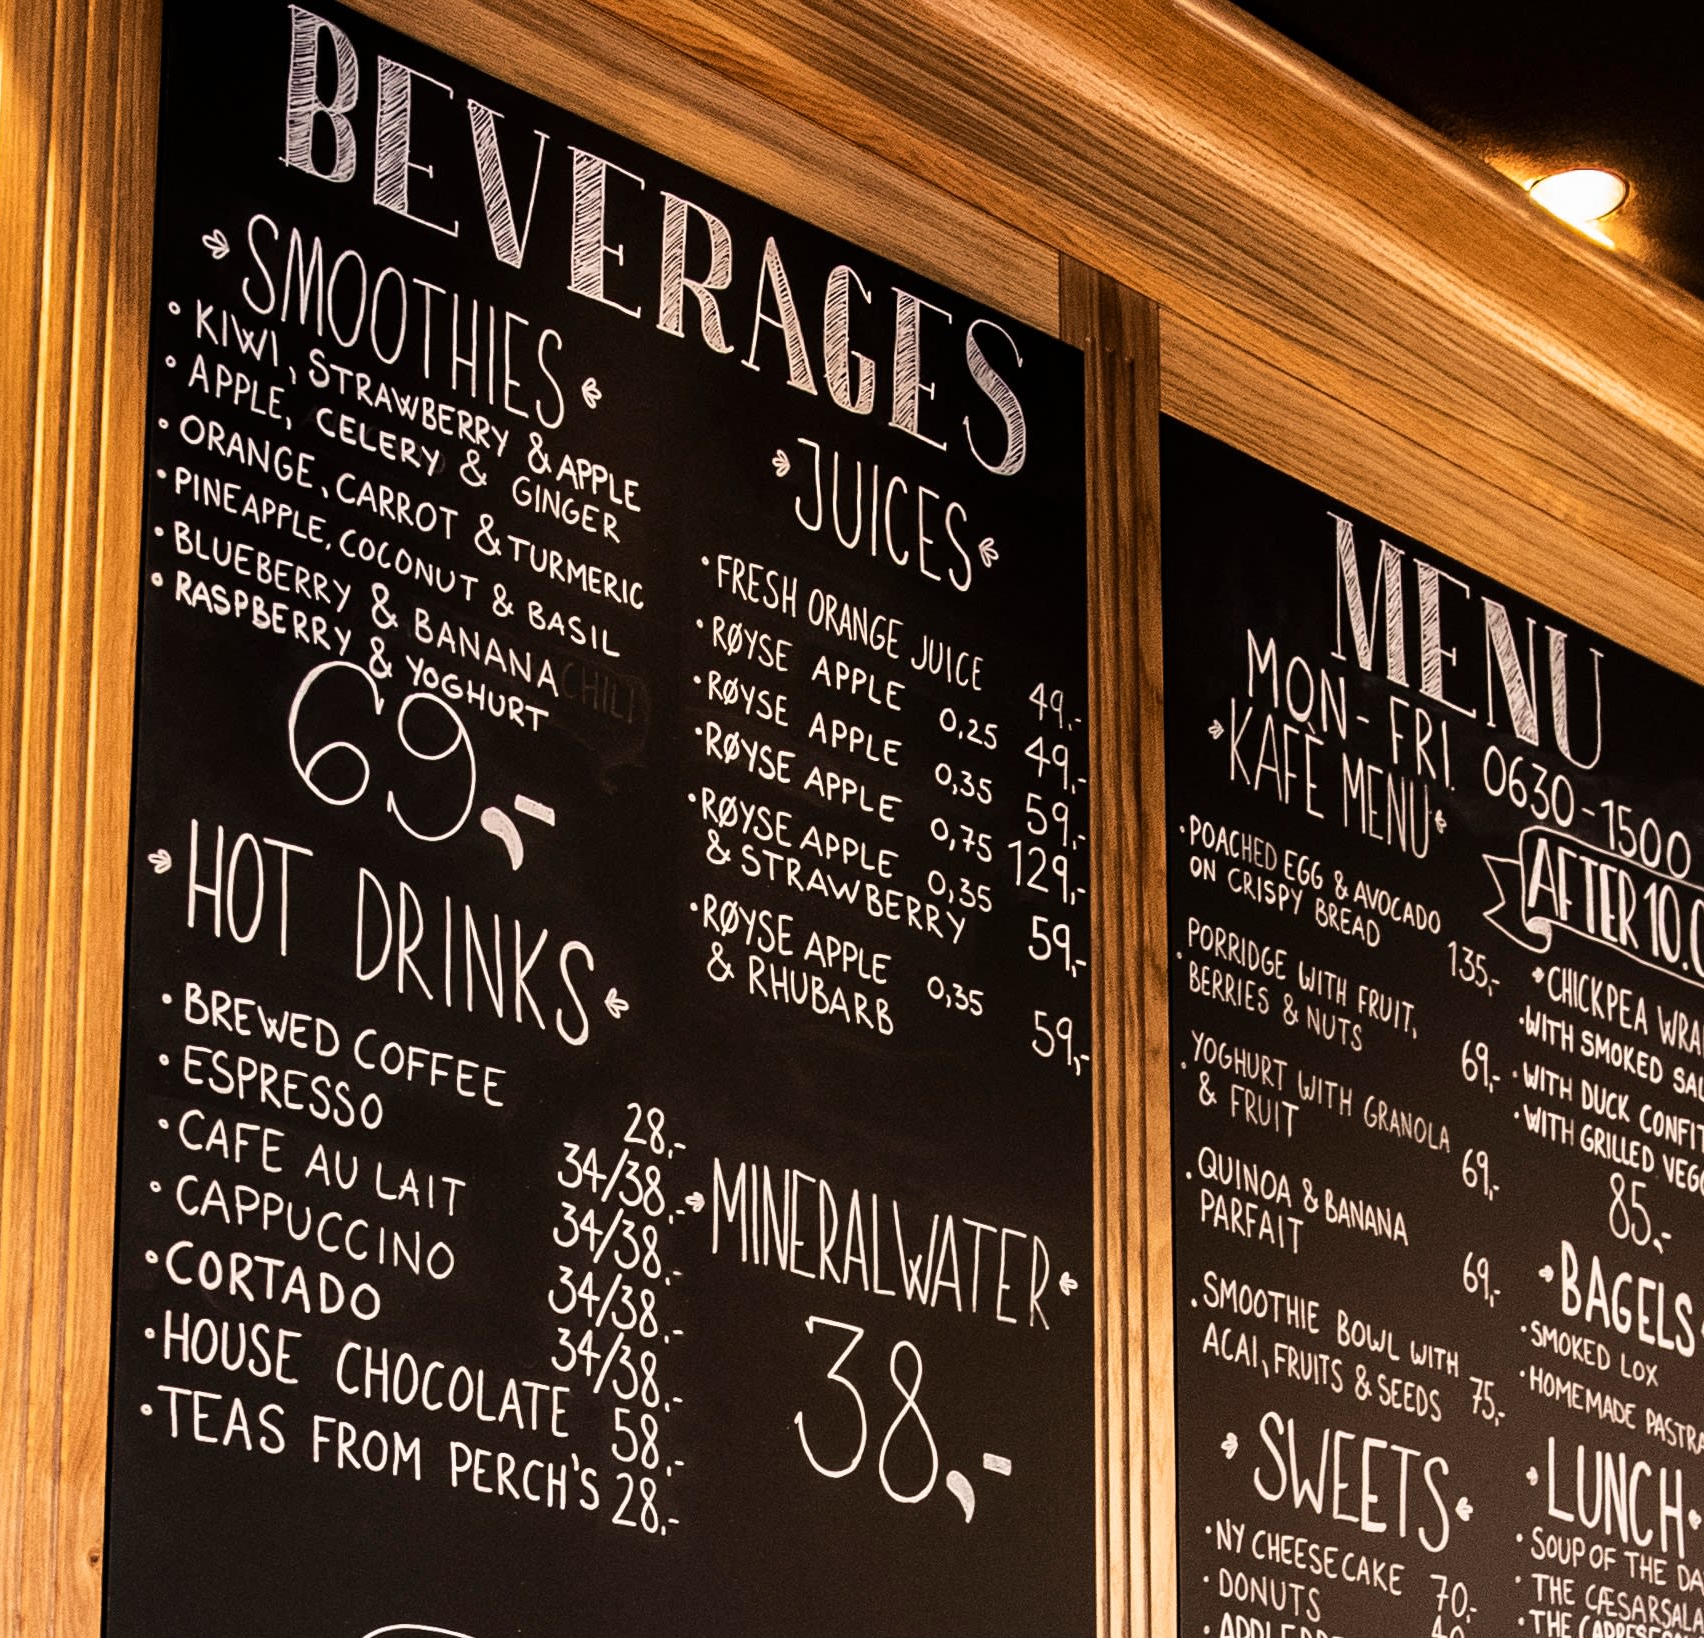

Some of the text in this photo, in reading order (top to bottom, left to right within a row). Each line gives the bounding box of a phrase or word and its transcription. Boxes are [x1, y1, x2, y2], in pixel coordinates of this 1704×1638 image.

[280, 4, 1028, 477] BEVERAGES
[242, 214, 564, 429] SMOOTHIES
[188, 354, 620, 543] APPLE, CELERY GINGER
[197, 299, 641, 512] KIWI, STRAWBERRY APPLE
[175, 467, 620, 657] PINEAPPLE, COCONUT BASIL
[180, 415, 644, 609] ORANGE, CARROT TURMERIC
[795, 437, 972, 592] JUICES
[174, 521, 351, 612] BLUEBERRY
[415, 608, 558, 697] BANANA
[176, 570, 351, 656] RASPBERRY
[406, 655, 549, 731] YOGHURT
[718, 554, 983, 691] FRESH ORANGE JUICE
[1326, 511, 1604, 770] MENU
[709, 670, 993, 805] RØYSE APPLE 0,35
[713, 616, 998, 750] RØYSE APPLE 0,25
[702, 787, 992, 913] RØYSE APPLE 0,35
[706, 721, 796, 783] RØYSE
[804, 766, 902, 822] APPLE
[930, 817, 993, 863] 0,75
[1342, 752, 1430, 859] MENU
[188, 819, 594, 1046] HOT DRINKS
[741, 844, 965, 944] STRAWBERRY
[1190, 814, 1440, 934] POACHED EGG AVOCADO
[1190, 856, 1215, 881] ON
[1228, 868, 1303, 914] CRISPY
[1316, 898, 1380, 947] BREAD
[1528, 838, 1639, 949] AFTER
[704, 893, 793, 956] RØYSE
[804, 931, 891, 984] APPLE
[927, 975, 984, 1017] 0,35
[749, 955, 893, 1035] RHUBARB
[1189, 917, 1417, 1039] PORRIDGE WITH FRUIT,
[1190, 961, 1362, 1051] BERRIES NUTS
[1547, 966, 1648, 1035] CHICKPEA
[184, 1045, 383, 1129] ESPRESSO
[185, 982, 506, 1107] BREWED COFFEE
[1192, 1030, 1450, 1153] YOGHURT WITH GRANOLA
[1523, 1062, 1572, 1101] WITH
[1582, 1080, 1630, 1122] DUCK
[1526, 1005, 1573, 1053] WITH
[1581, 1030, 1663, 1084] SMOKED
[179, 1109, 466, 1216] CAFE AU LAIT
[1231, 1084, 1299, 1137] FRUIT
[1523, 1104, 1574, 1145] WITH
[1580, 1124, 1654, 1172] GRILLED
[176, 1175, 454, 1279] CAPPUCCINO
[712, 1157, 1050, 1331] MINERALWATER
[1198, 1147, 1408, 1246] QUINOA BANANA
[1201, 1188, 1304, 1254] PARFAIT
[166, 1241, 380, 1320] CORTADO
[1203, 1271, 1458, 1377] SMOOTHIE BOWL WITH
[1561, 1240, 1695, 1357] BAGELS
[164, 1310, 570, 1437] HOUSE CHOCOLATE
[1203, 1322, 1269, 1378] ACAI,
[1275, 1343, 1343, 1393] FRUITS
[1378, 1374, 1441, 1422] SEEDS
[1530, 1365, 1636, 1429] HOMEMADE
[1531, 1320, 1658, 1386] SMOKED LOX
[157, 1385, 599, 1510] TEAS FROM PERCH'S
[1253, 1411, 1450, 1553] SWEETS
[1548, 1436, 1685, 1559] LUNCH
[1217, 1519, 1245, 1553] NY
[1219, 1568, 1320, 1622] DONUTS
[1531, 1526, 1585, 1567] SOUP
[1589, 1544, 1616, 1571] OF
[1624, 1551, 1667, 1585] THE
[1532, 1573, 1575, 1605] THE
